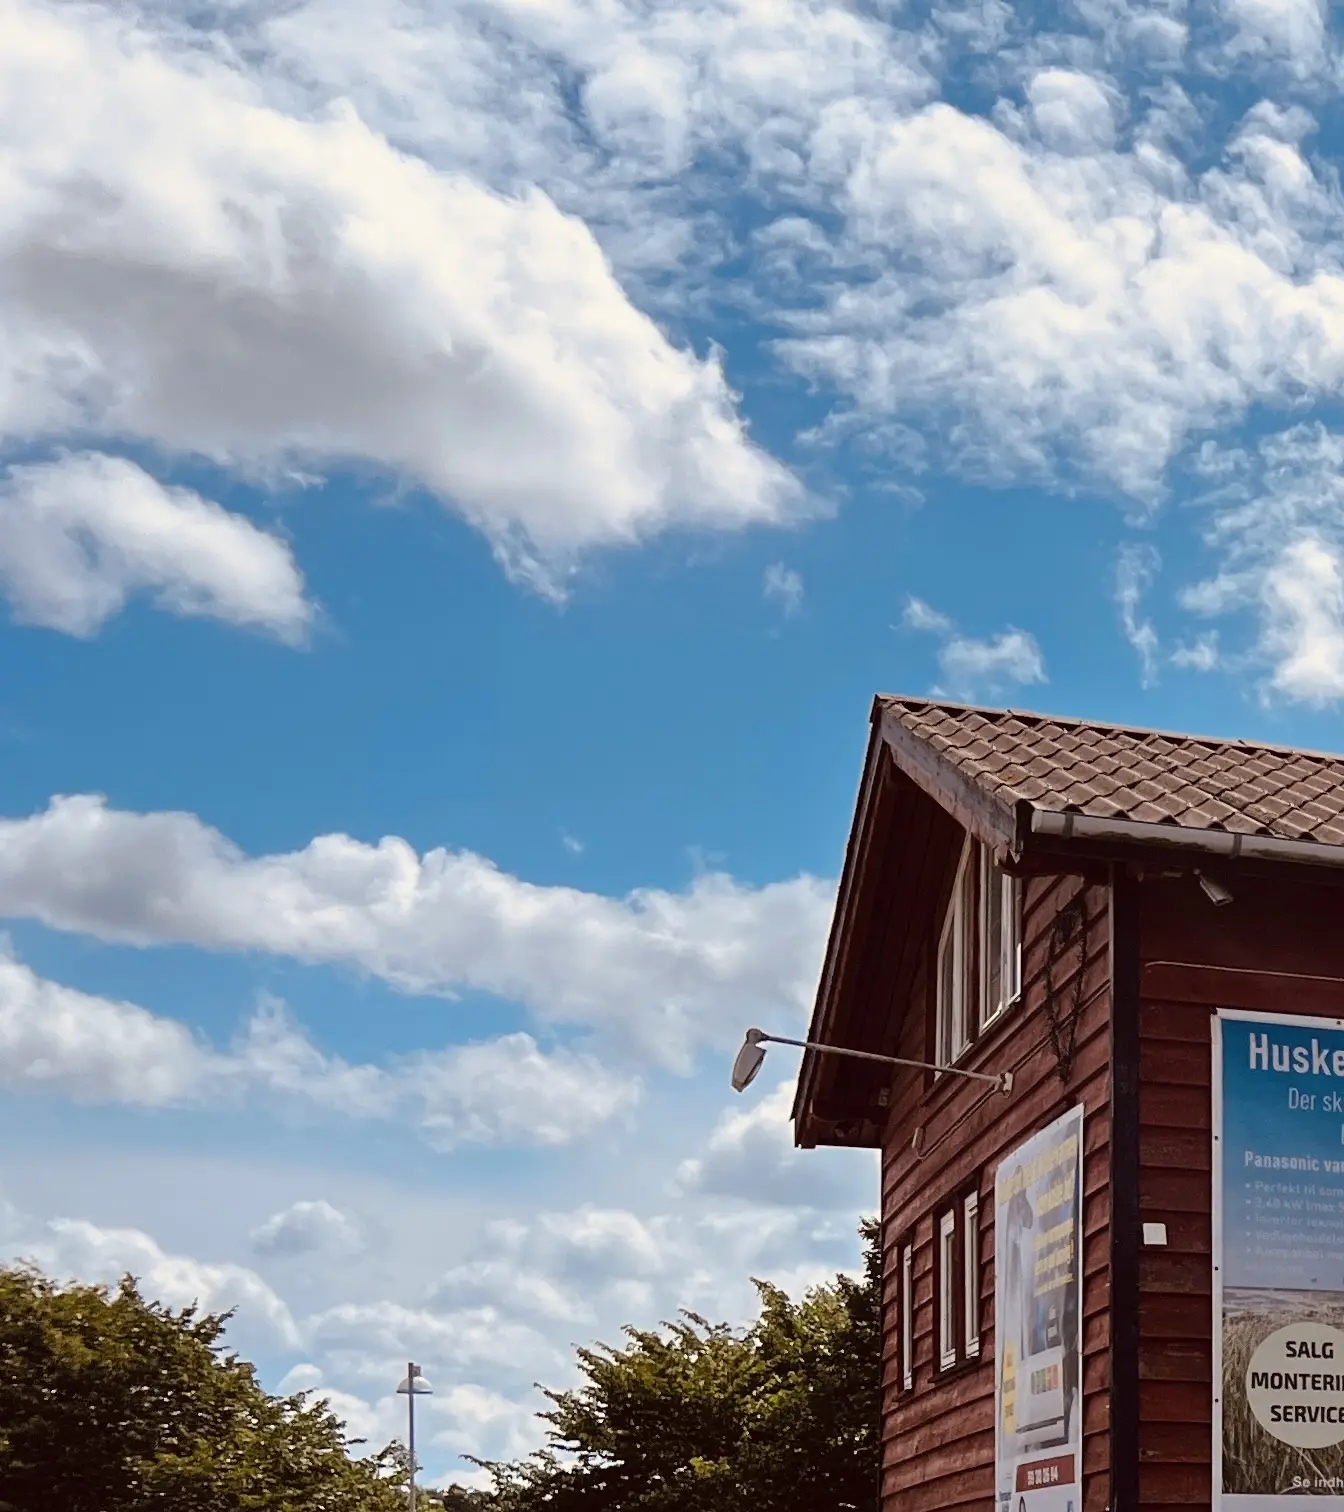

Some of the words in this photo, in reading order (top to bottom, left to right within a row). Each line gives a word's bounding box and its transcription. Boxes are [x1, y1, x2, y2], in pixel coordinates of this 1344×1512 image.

[1288, 1087, 1317, 1110] Der
[1244, 1150, 1320, 1172] Panasonic
[1285, 1340, 1334, 1360] SALG
[1292, 1475, 1311, 1489] Se
